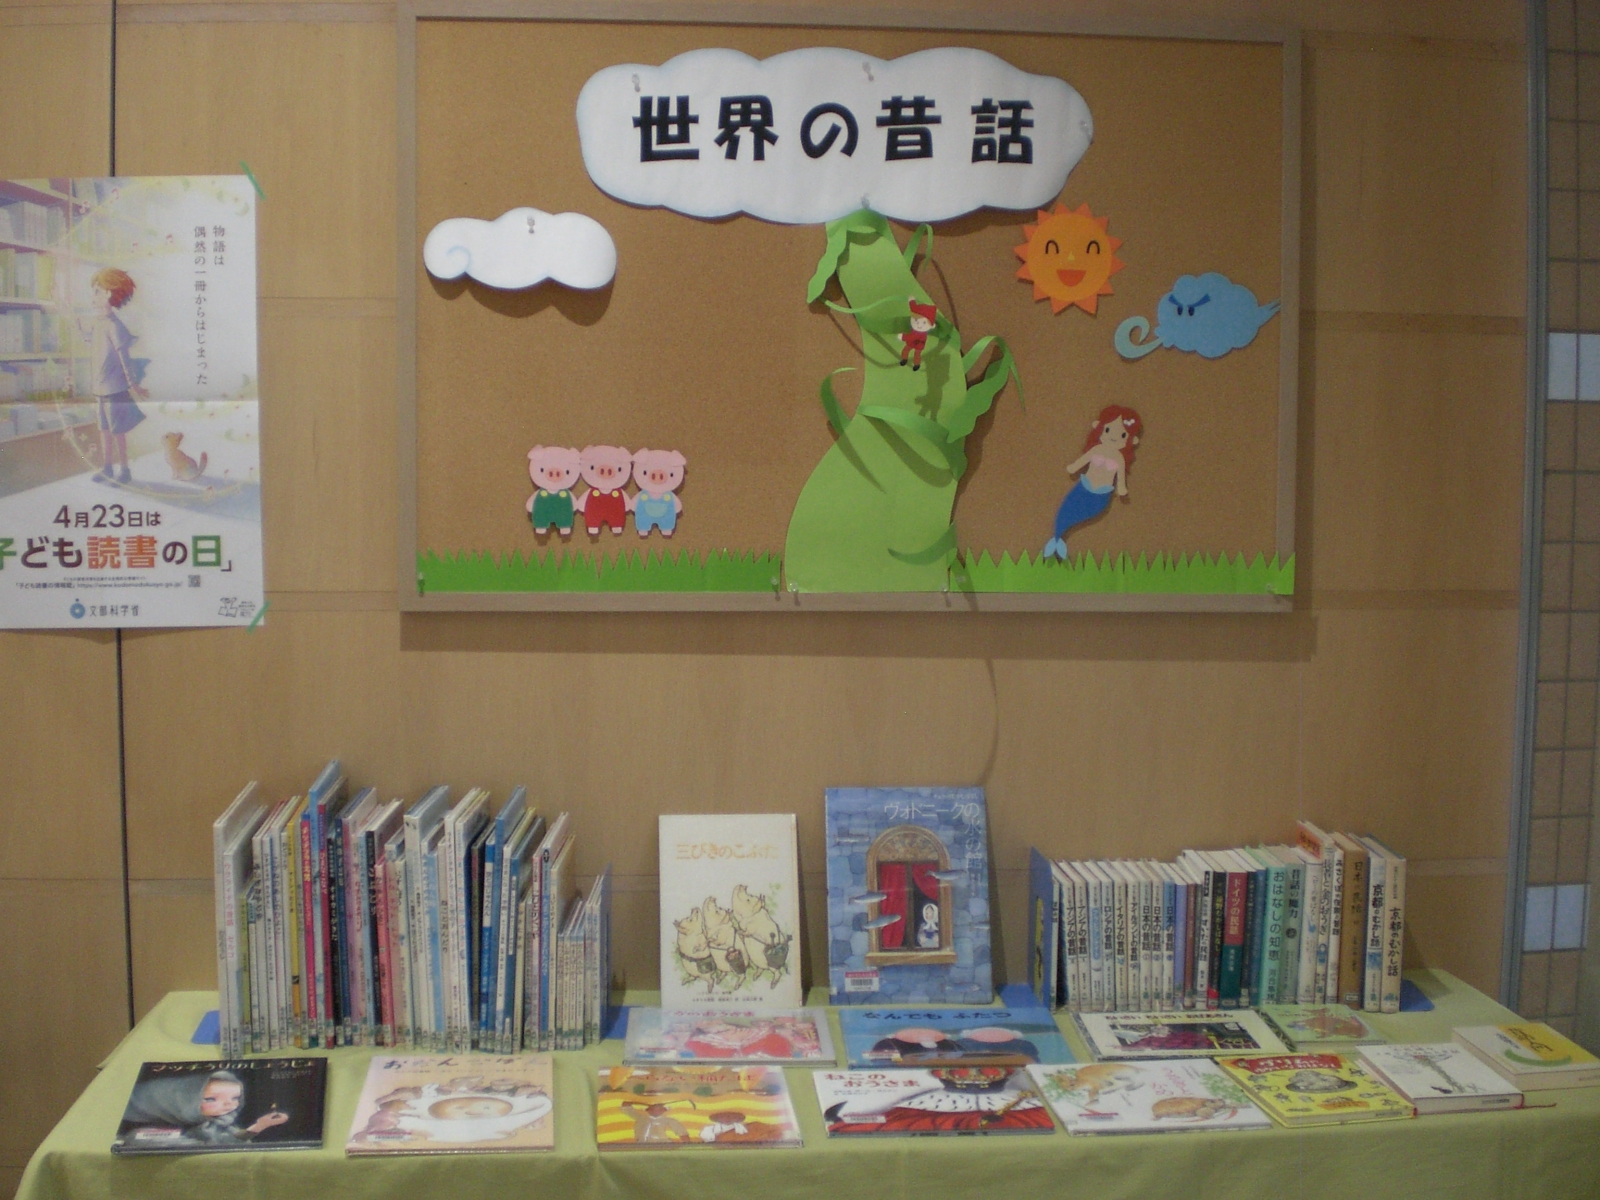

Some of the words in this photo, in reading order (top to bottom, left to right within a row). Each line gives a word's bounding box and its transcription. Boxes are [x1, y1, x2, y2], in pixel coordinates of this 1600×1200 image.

[632, 96, 1036, 164] 世界の昔話
[212, 225, 226, 265] 物語は
[194, 225, 208, 386] 偶然の一冊からはじまった
[53, 503, 161, 528] 4月23日は
[90, 604, 140, 618] 文部科学省
[884, 801, 980, 821] ヴォドニークの
[675, 842, 779, 861] 三びきのこぶた
[1103, 906, 1113, 951] ロシアの昔話
[1115, 906, 1125, 956] イタリアの昔話
[1142, 906, 1151, 952] 日本の昔話
[1152, 906, 1162, 952] 日本の昔話
[1267, 871, 1285, 961] おはなしの知恵
[1369, 884, 1384, 948] 京都のむかし話
[1386, 906, 1402, 977] 京都のむかし話
